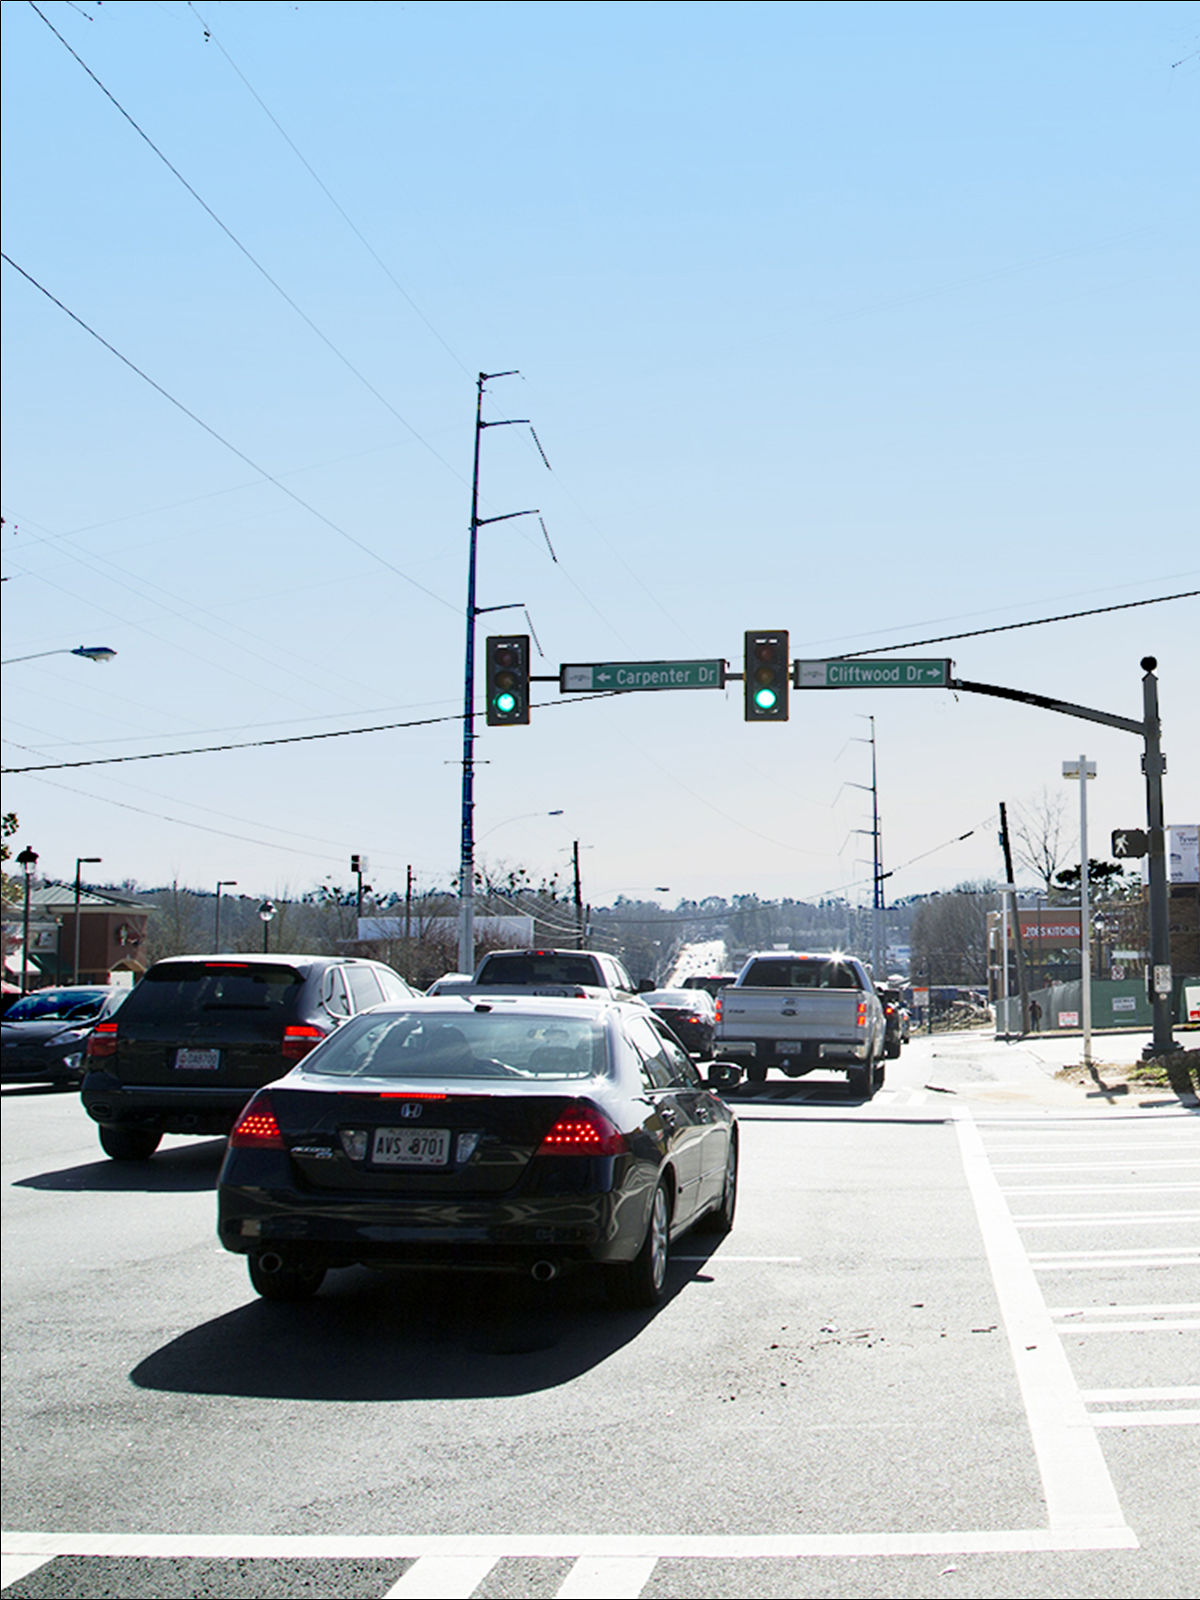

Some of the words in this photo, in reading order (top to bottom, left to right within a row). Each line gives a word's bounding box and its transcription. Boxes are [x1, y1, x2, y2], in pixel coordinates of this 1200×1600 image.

[616, 668, 691, 686] Carpenter
[698, 666, 715, 682] Dr
[829, 665, 900, 682] Cliftwood
[906, 665, 924, 681] Dr
[376, 1137, 402, 1154] AVS
[411, 1137, 444, 1156] 8701
